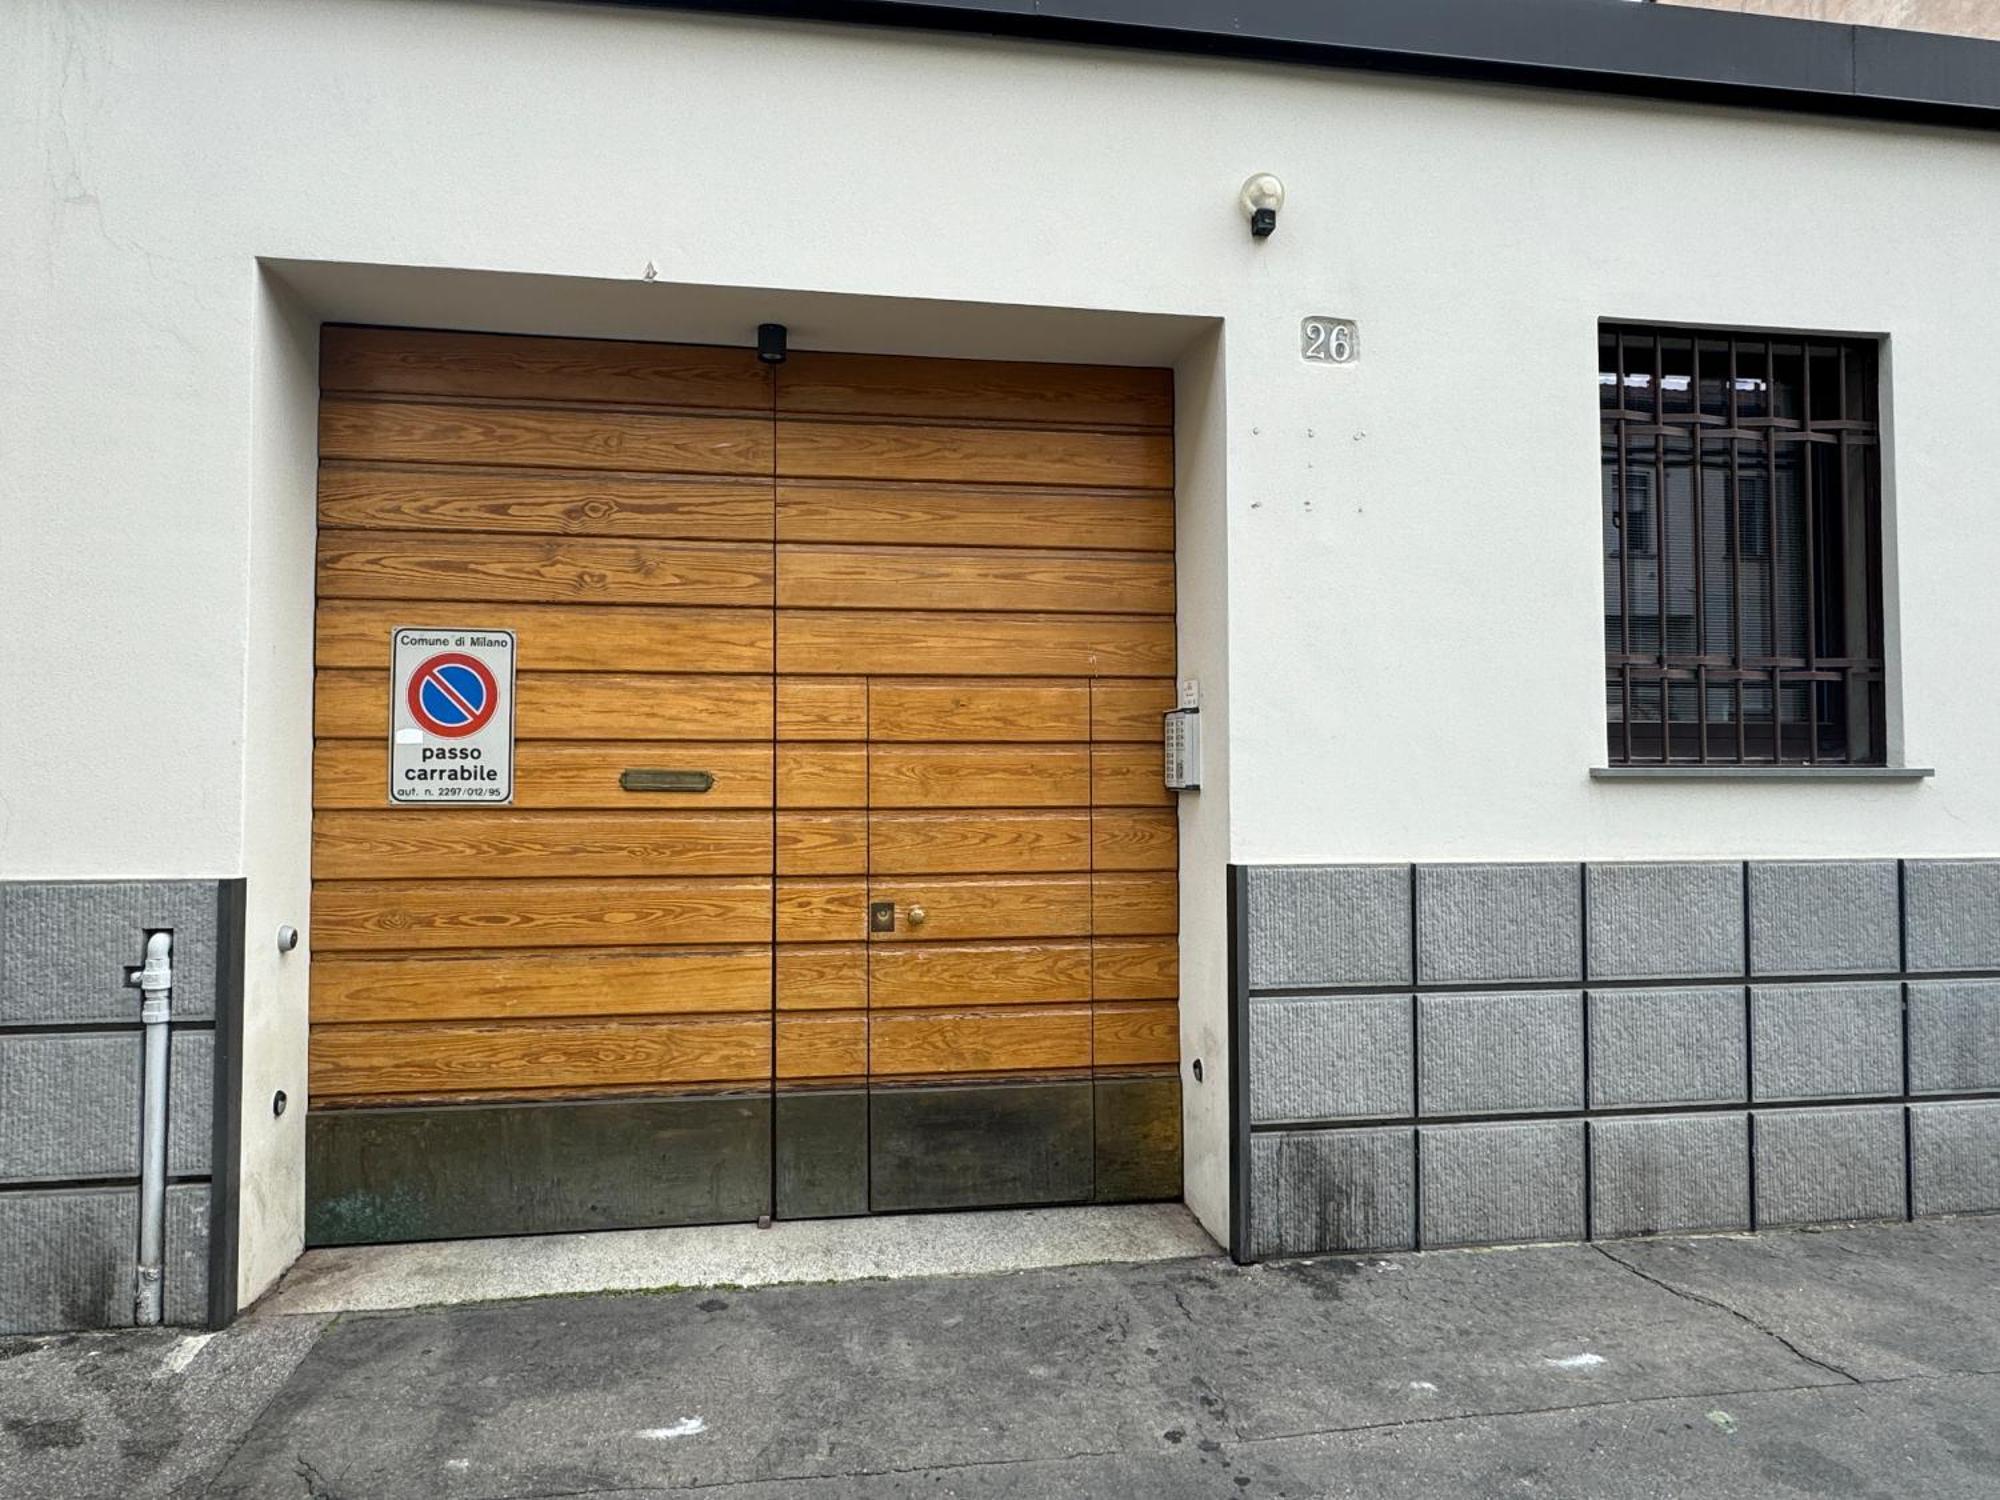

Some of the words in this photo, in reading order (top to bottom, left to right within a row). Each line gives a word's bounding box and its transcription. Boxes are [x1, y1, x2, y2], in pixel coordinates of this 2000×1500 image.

[1306, 323, 1350, 361] 26
[400, 634, 450, 647] Comune
[455, 635, 465, 647] di
[470, 636, 508, 648] Milano
[421, 747, 482, 763] passo
[404, 765, 498, 781] carrabile
[397, 787, 419, 797] aut.
[424, 788, 434, 796] n.
[438, 787, 501, 797] 2297/012/95
